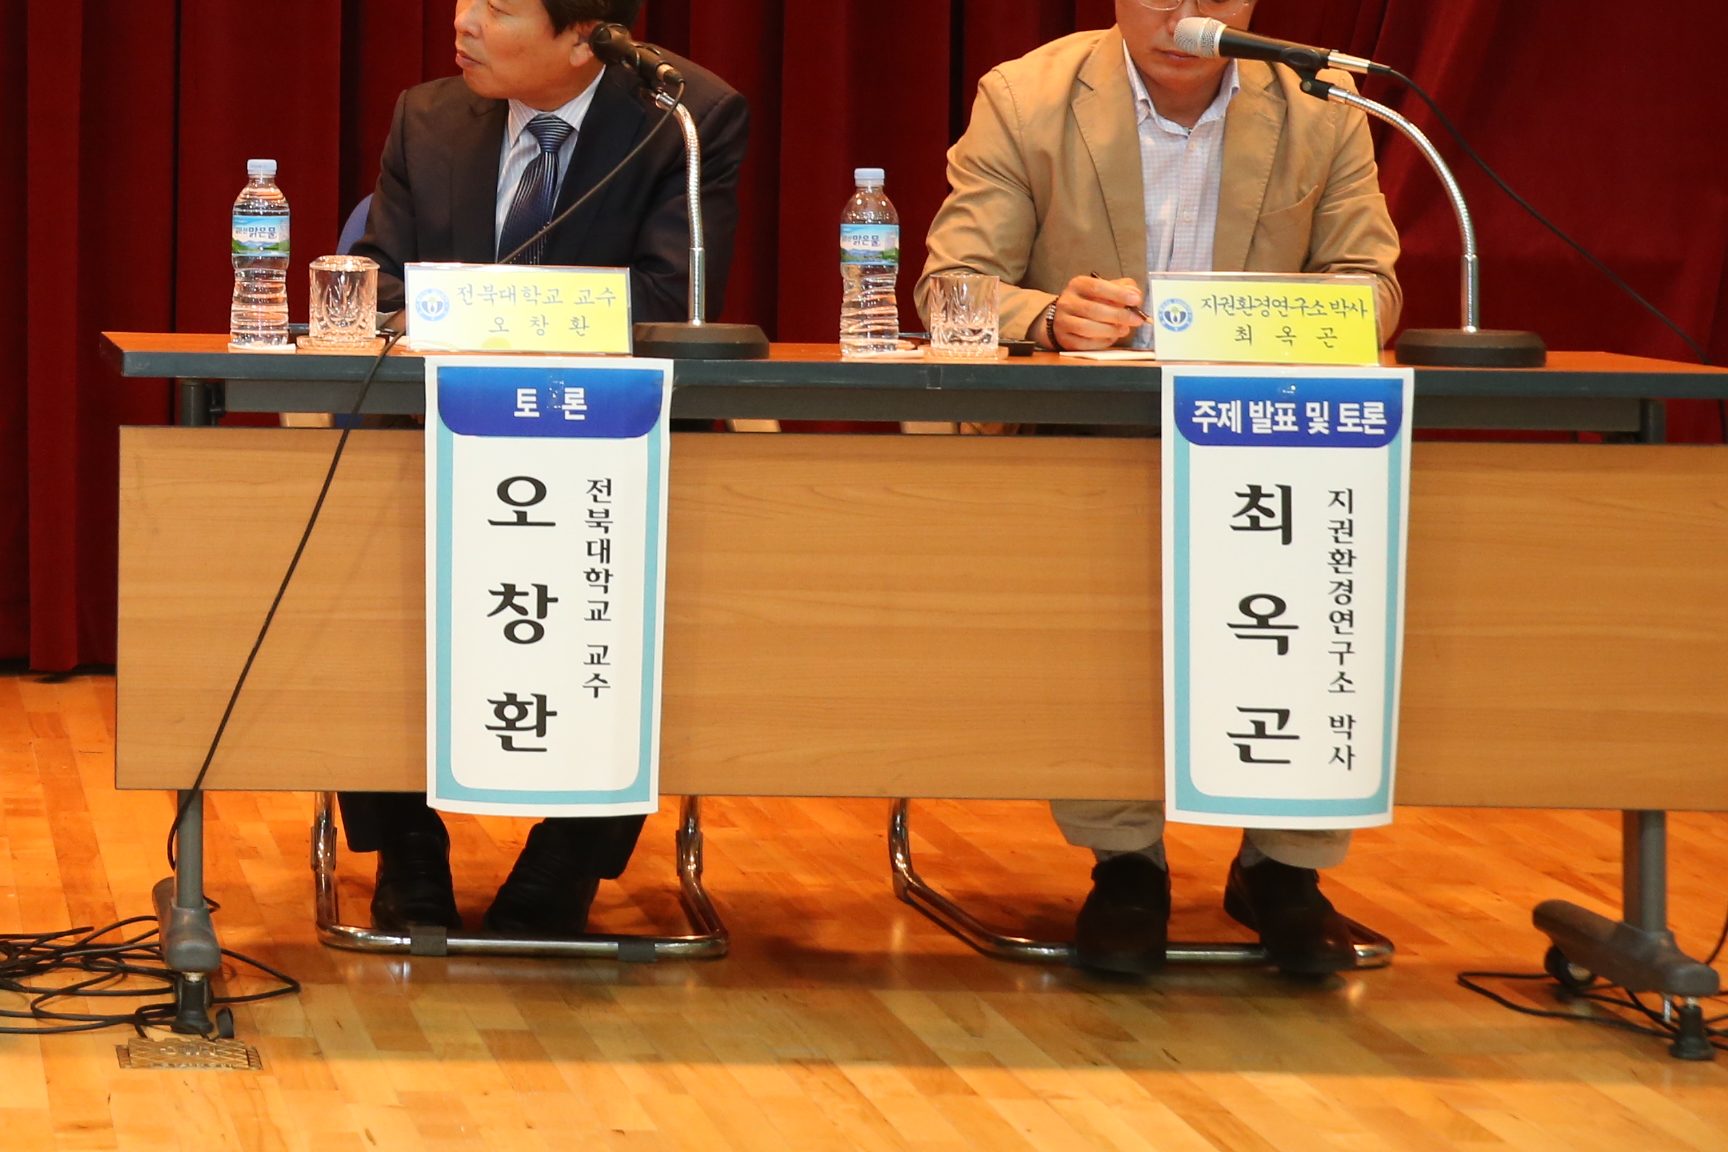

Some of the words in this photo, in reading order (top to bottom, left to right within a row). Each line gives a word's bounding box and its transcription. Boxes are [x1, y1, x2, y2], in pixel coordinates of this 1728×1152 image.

[456, 283, 564, 306] 전북대학교
[574, 287, 616, 307] 교수
[1192, 400, 1242, 433] 주제
[1249, 400, 1298, 433] 발표
[1306, 401, 1329, 434] 및
[1337, 402, 1387, 434] 토론
[584, 478, 613, 621] 전북대학교
[1328, 488, 1357, 693] 지권환경연구소
[583, 645, 610, 698] 교수
[1329, 714, 1356, 771] 박사
